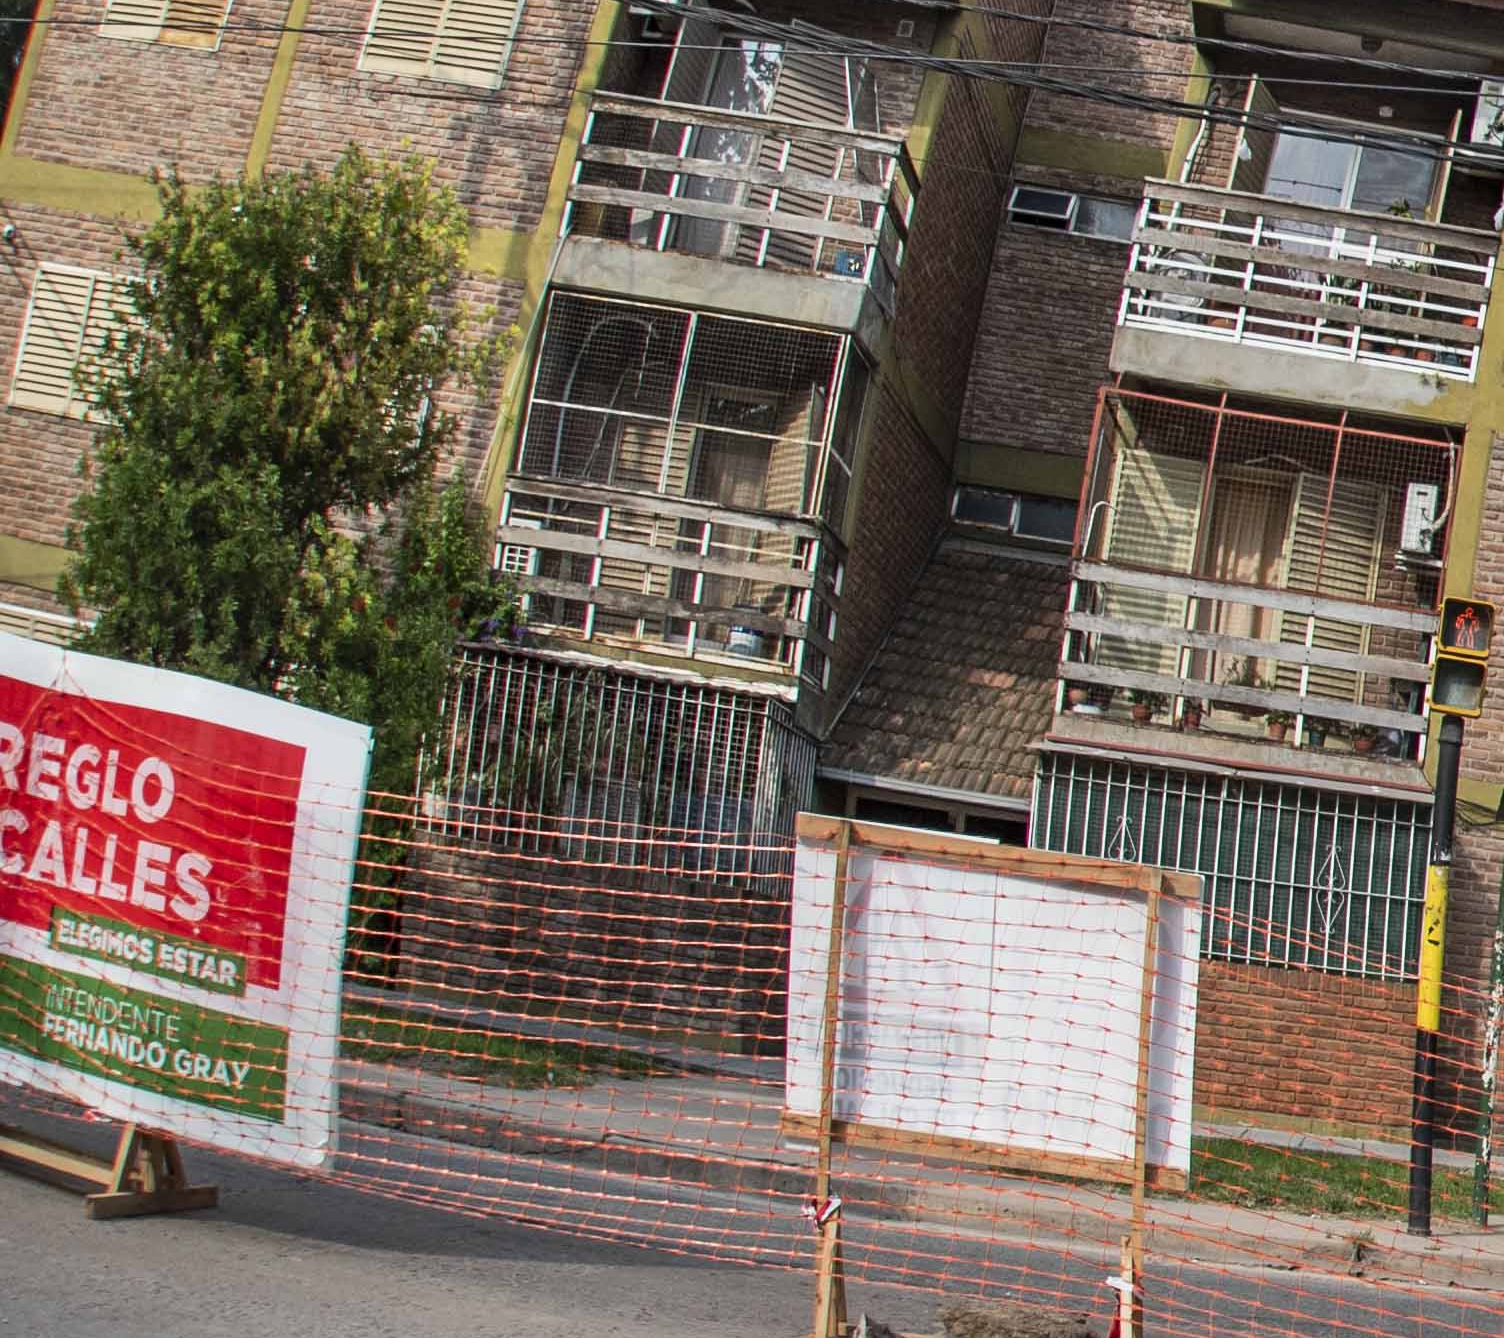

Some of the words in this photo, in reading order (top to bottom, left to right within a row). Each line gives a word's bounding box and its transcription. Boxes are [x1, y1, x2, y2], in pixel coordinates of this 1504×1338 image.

[0, 807, 213, 921] CALLES
[55, 918, 155, 964] ELEGIMOS
[157, 943, 239, 988] ESTAR
[45, 983, 182, 1043] INTENDENTE
[41, 1012, 167, 1069] FERNANDO
[173, 1048, 250, 1090] GRAY
